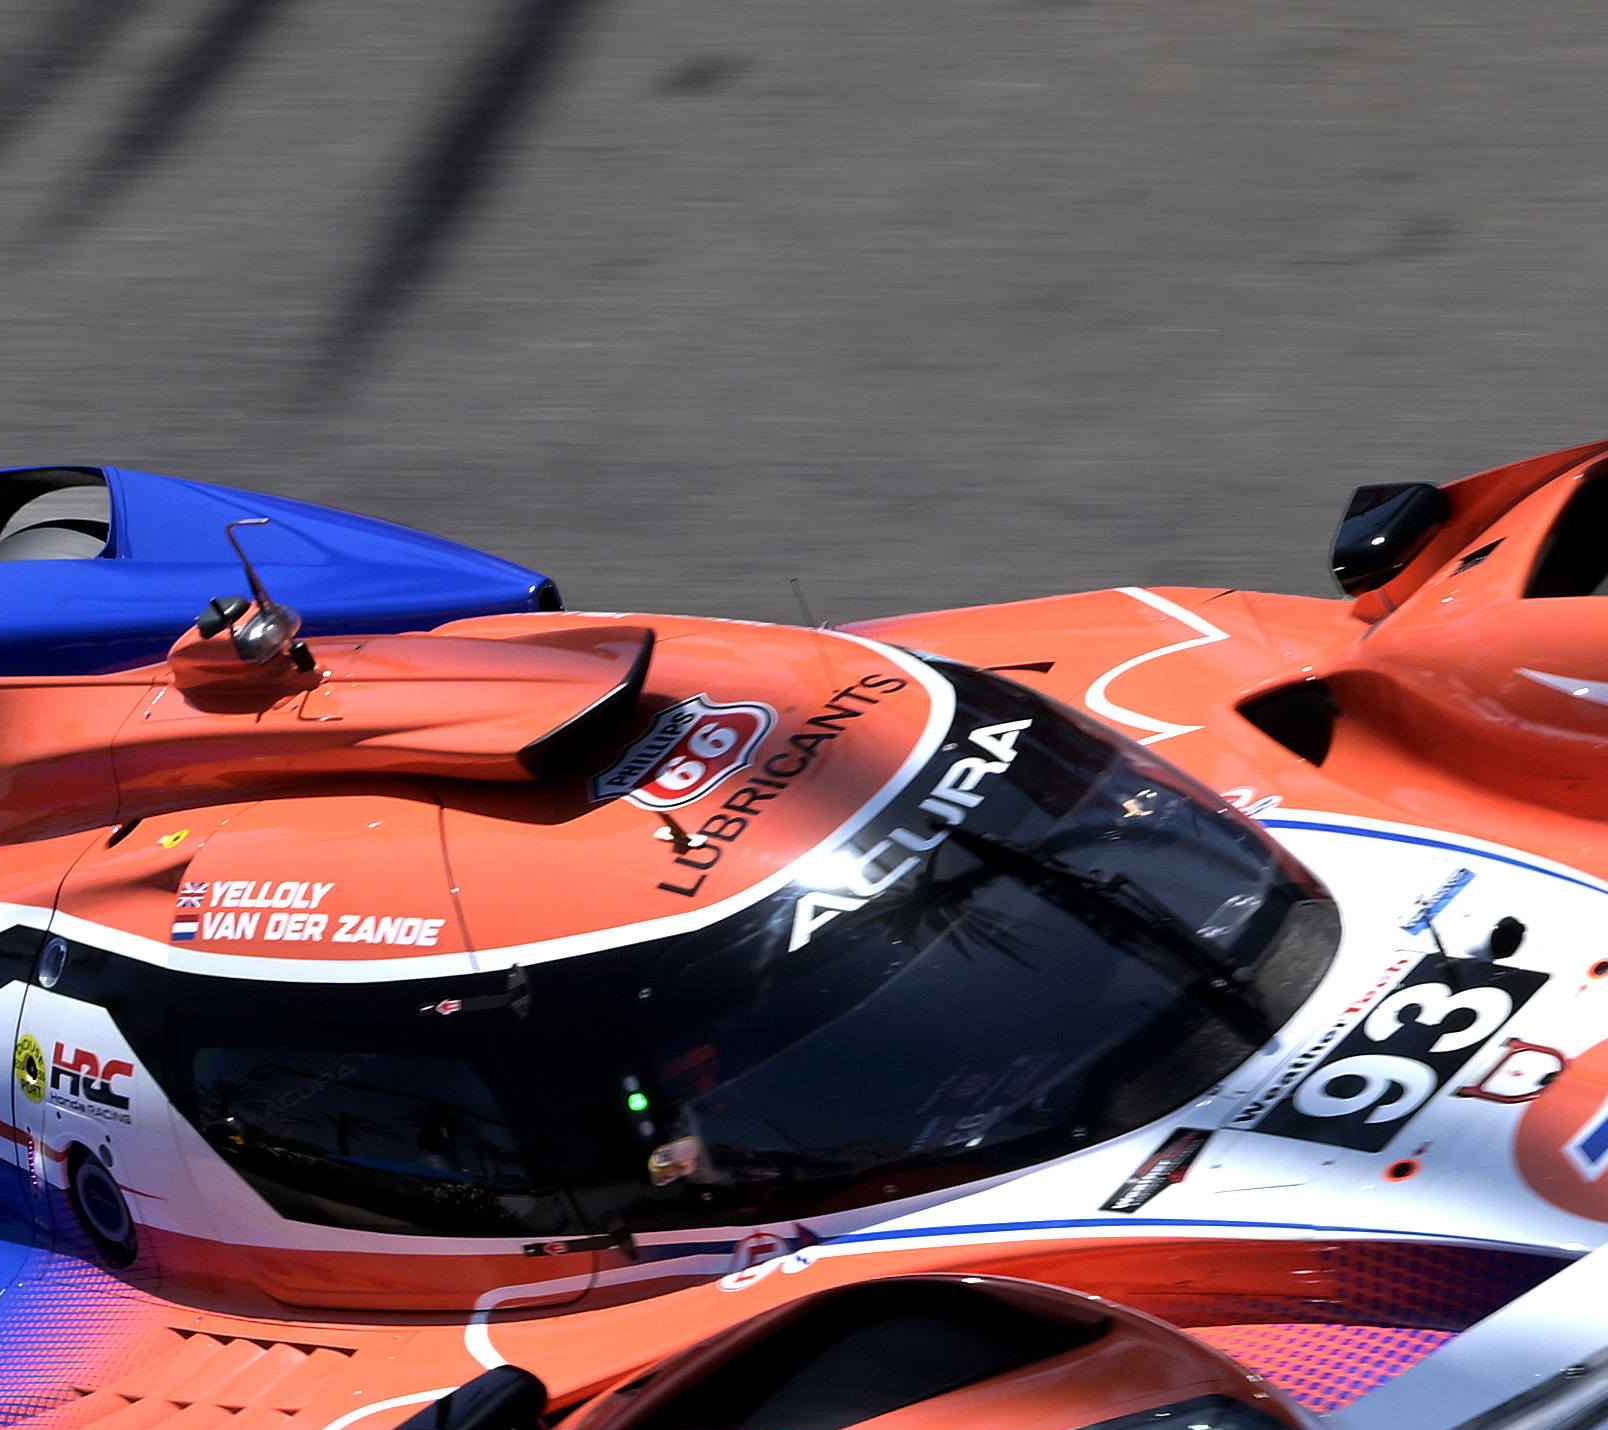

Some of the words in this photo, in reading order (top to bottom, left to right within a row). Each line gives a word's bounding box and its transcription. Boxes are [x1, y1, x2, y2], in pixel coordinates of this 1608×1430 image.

[607, 709, 695, 790] PHILLIPS
[656, 721, 738, 791] 66
[658, 672, 908, 898] LUBRICANTS
[788, 717, 1033, 953] ACURA
[202, 912, 256, 941] VAN
[263, 914, 329, 943] DER
[331, 915, 446, 947] ZANDE
[208, 881, 335, 909] YELLOLY
[50, 1040, 136, 1111] HRC
[1292, 982, 1514, 1124] 93
[49, 1092, 86, 1114] Honda
[86, 1104, 133, 1125] RACING
